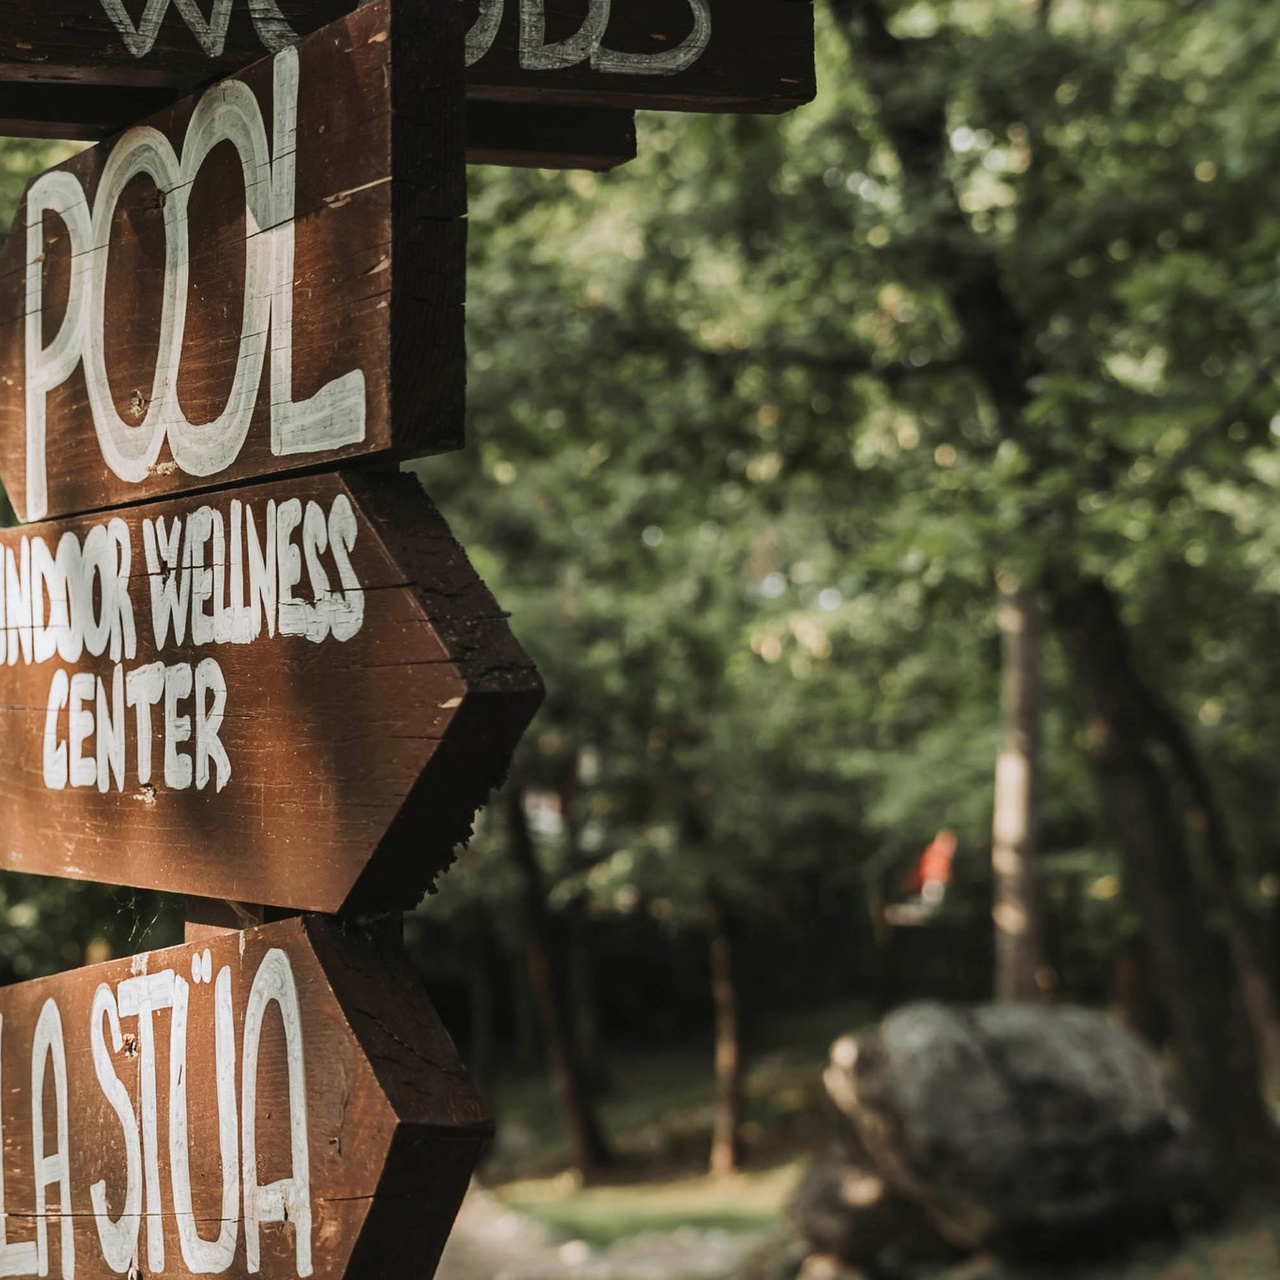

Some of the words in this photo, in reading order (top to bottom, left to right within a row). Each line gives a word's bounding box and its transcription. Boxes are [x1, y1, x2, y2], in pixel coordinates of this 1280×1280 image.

[25, 45, 367, 523] POOL
[142, 493, 366, 651] WELLNESS
[42, 657, 232, 794] CENTER
